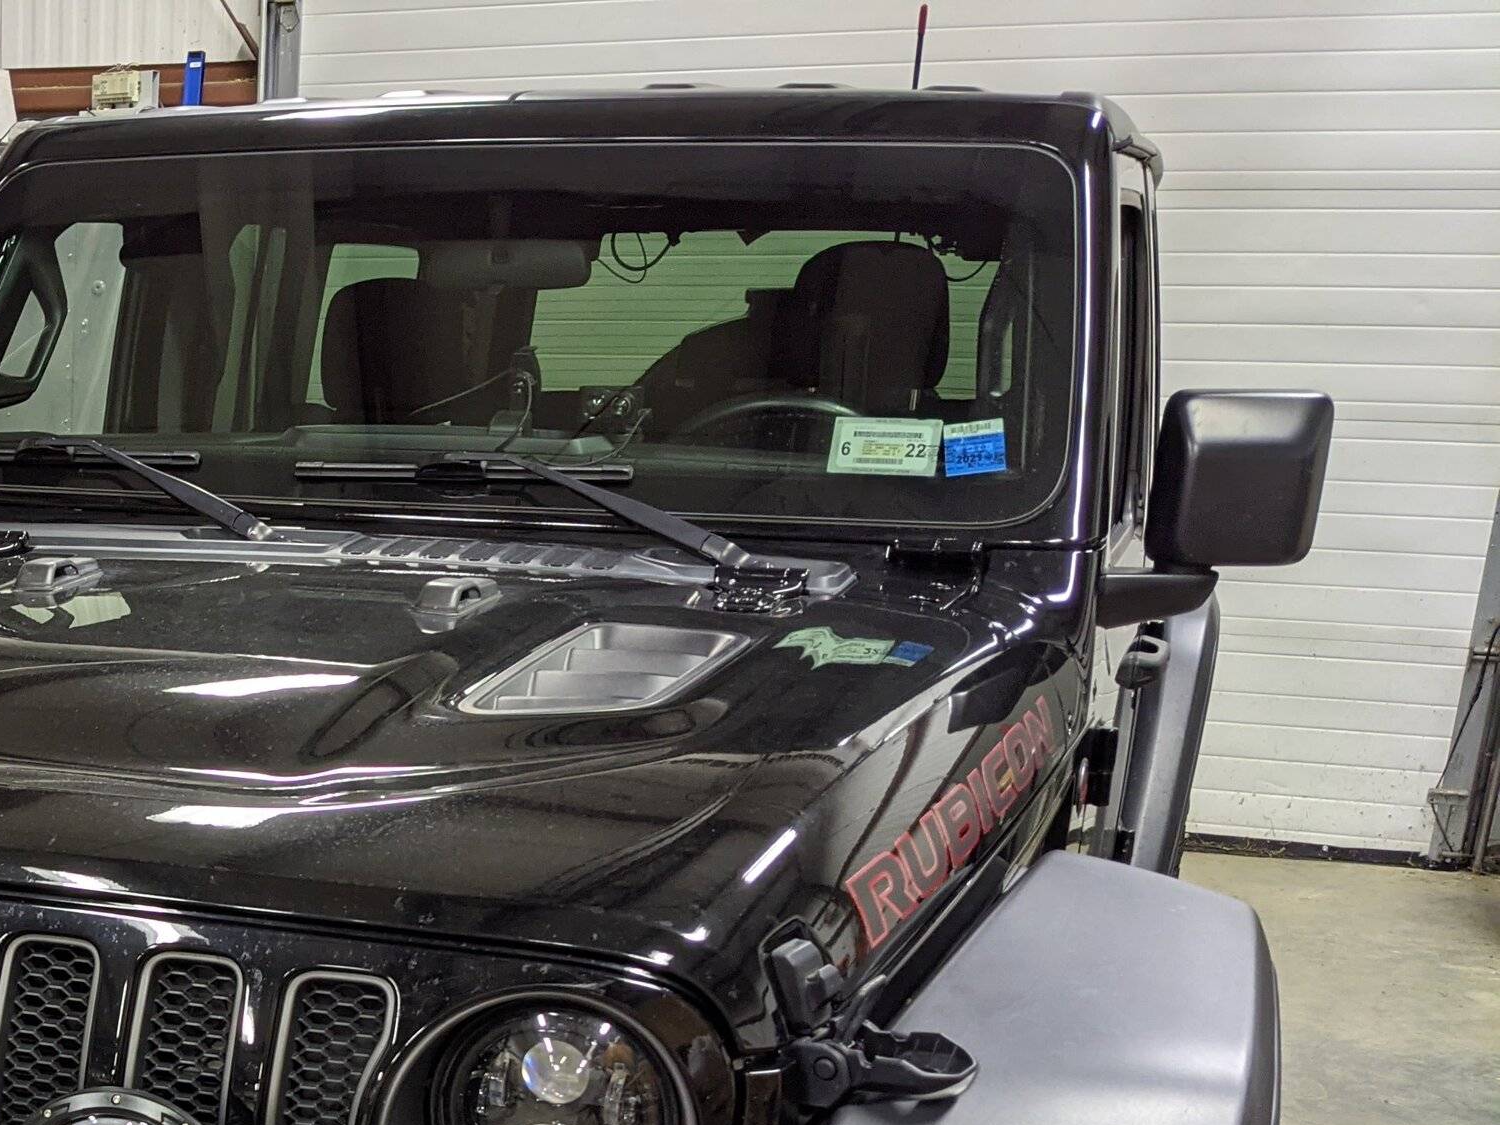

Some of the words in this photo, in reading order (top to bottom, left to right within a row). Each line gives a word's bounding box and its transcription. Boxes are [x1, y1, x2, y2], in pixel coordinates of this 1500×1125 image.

[841, 442, 851, 456] 6
[905, 444, 927, 458] 22
[845, 695, 1055, 949] RUBICON
